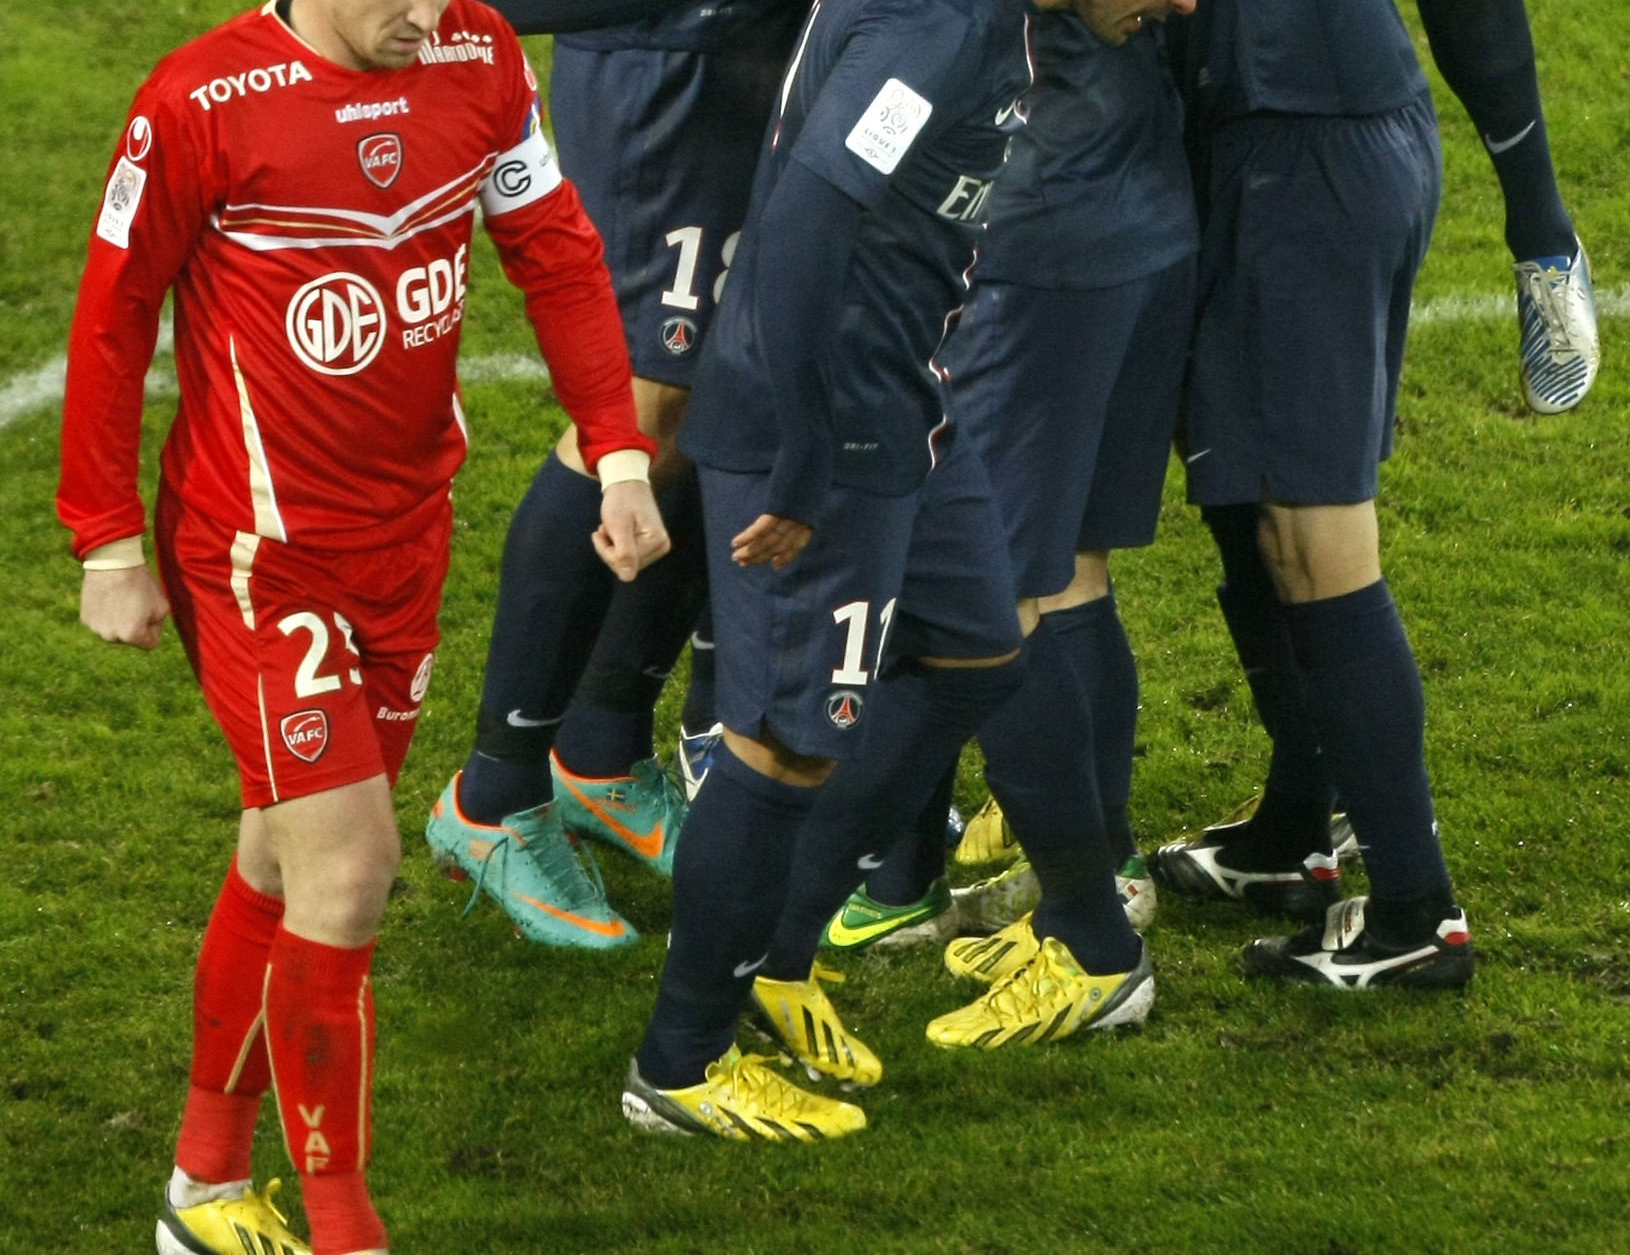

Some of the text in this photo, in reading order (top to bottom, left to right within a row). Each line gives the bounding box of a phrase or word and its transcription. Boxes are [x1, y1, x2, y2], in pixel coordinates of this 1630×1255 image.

[189, 60, 313, 111] TOYOTA
[335, 96, 410, 124] uhlsport
[364, 152, 398, 169] VAFC
[493, 160, 531, 197] C
[396, 243, 467, 324] GDE
[296, 283, 379, 363] GDE
[287, 727, 324, 746] VAFC
